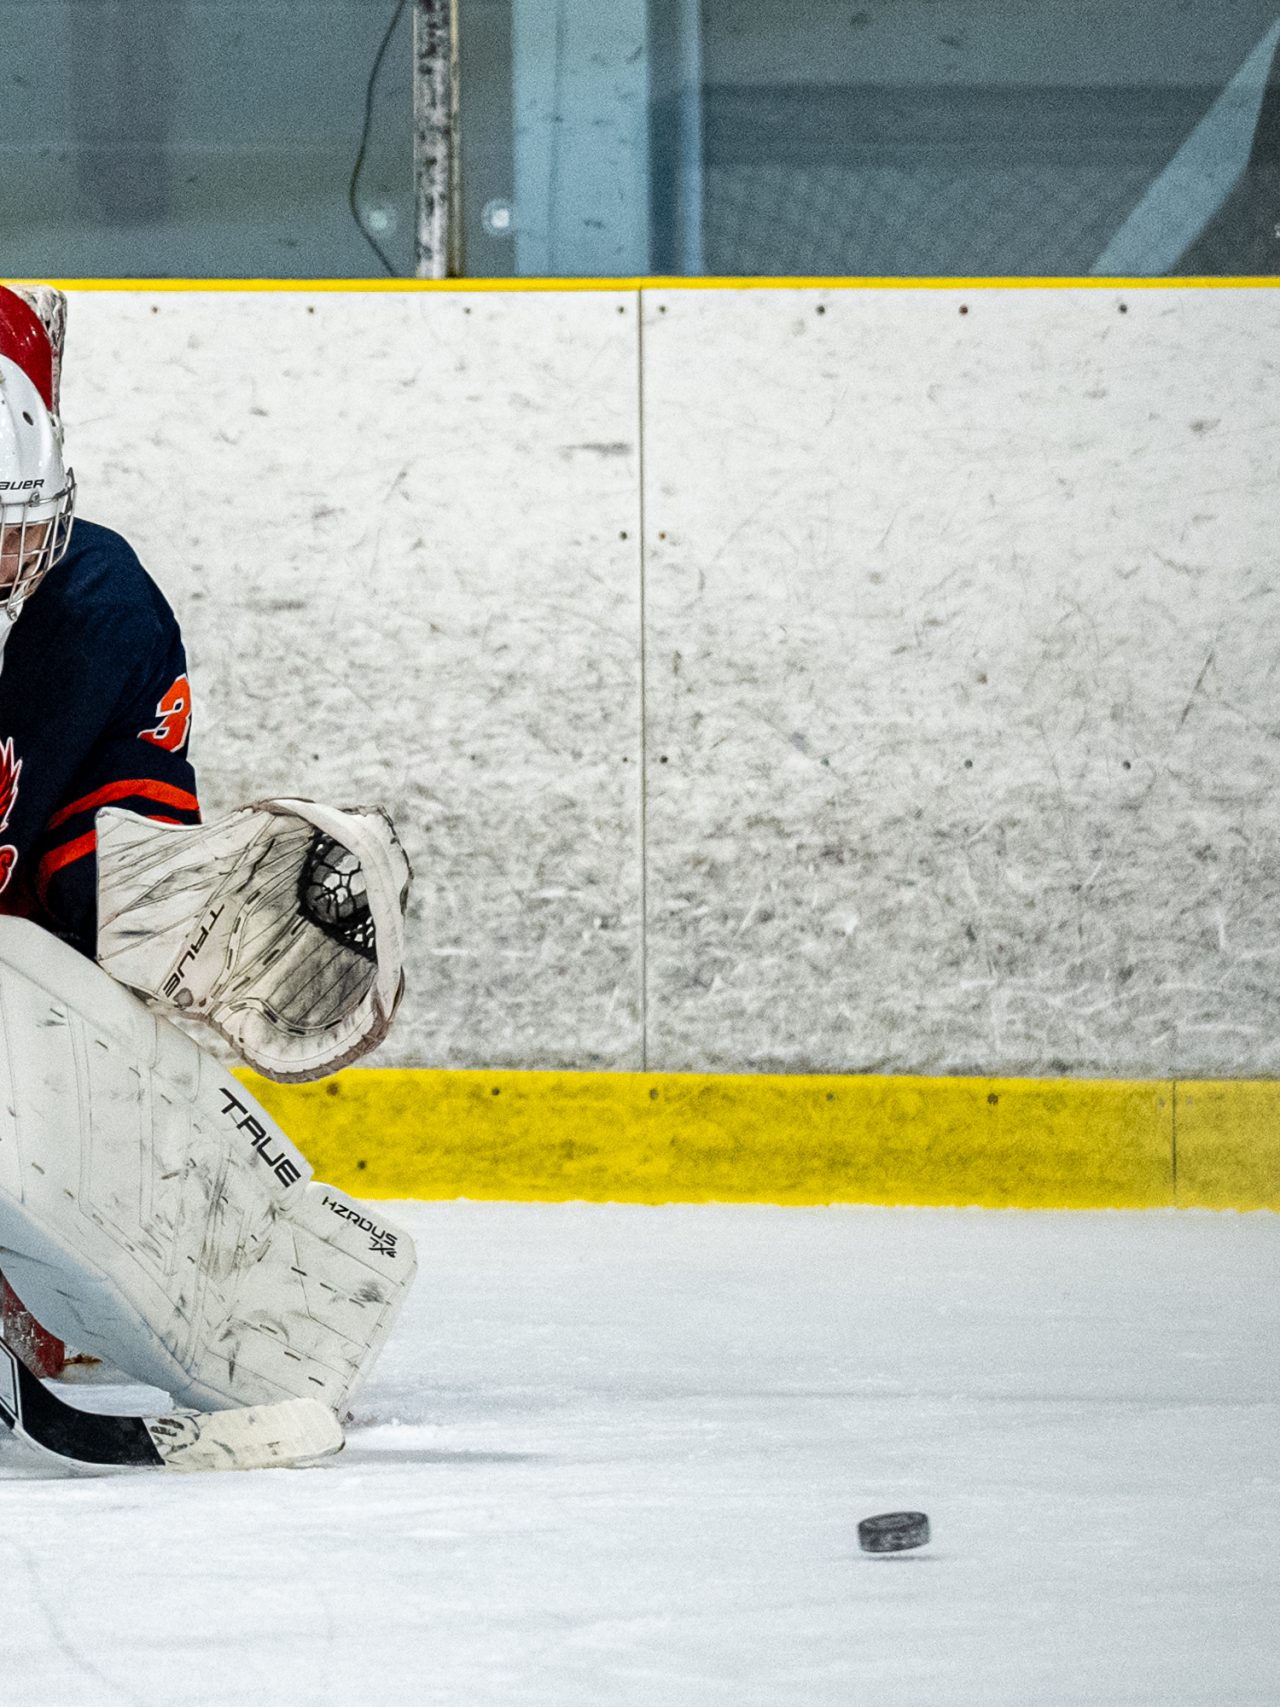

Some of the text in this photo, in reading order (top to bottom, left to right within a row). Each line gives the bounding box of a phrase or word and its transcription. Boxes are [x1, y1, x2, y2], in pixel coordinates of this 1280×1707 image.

[162, 904, 225, 998] TRUE
[218, 1087, 301, 1188] TRUE
[321, 1196, 398, 1247] HZRDUS
